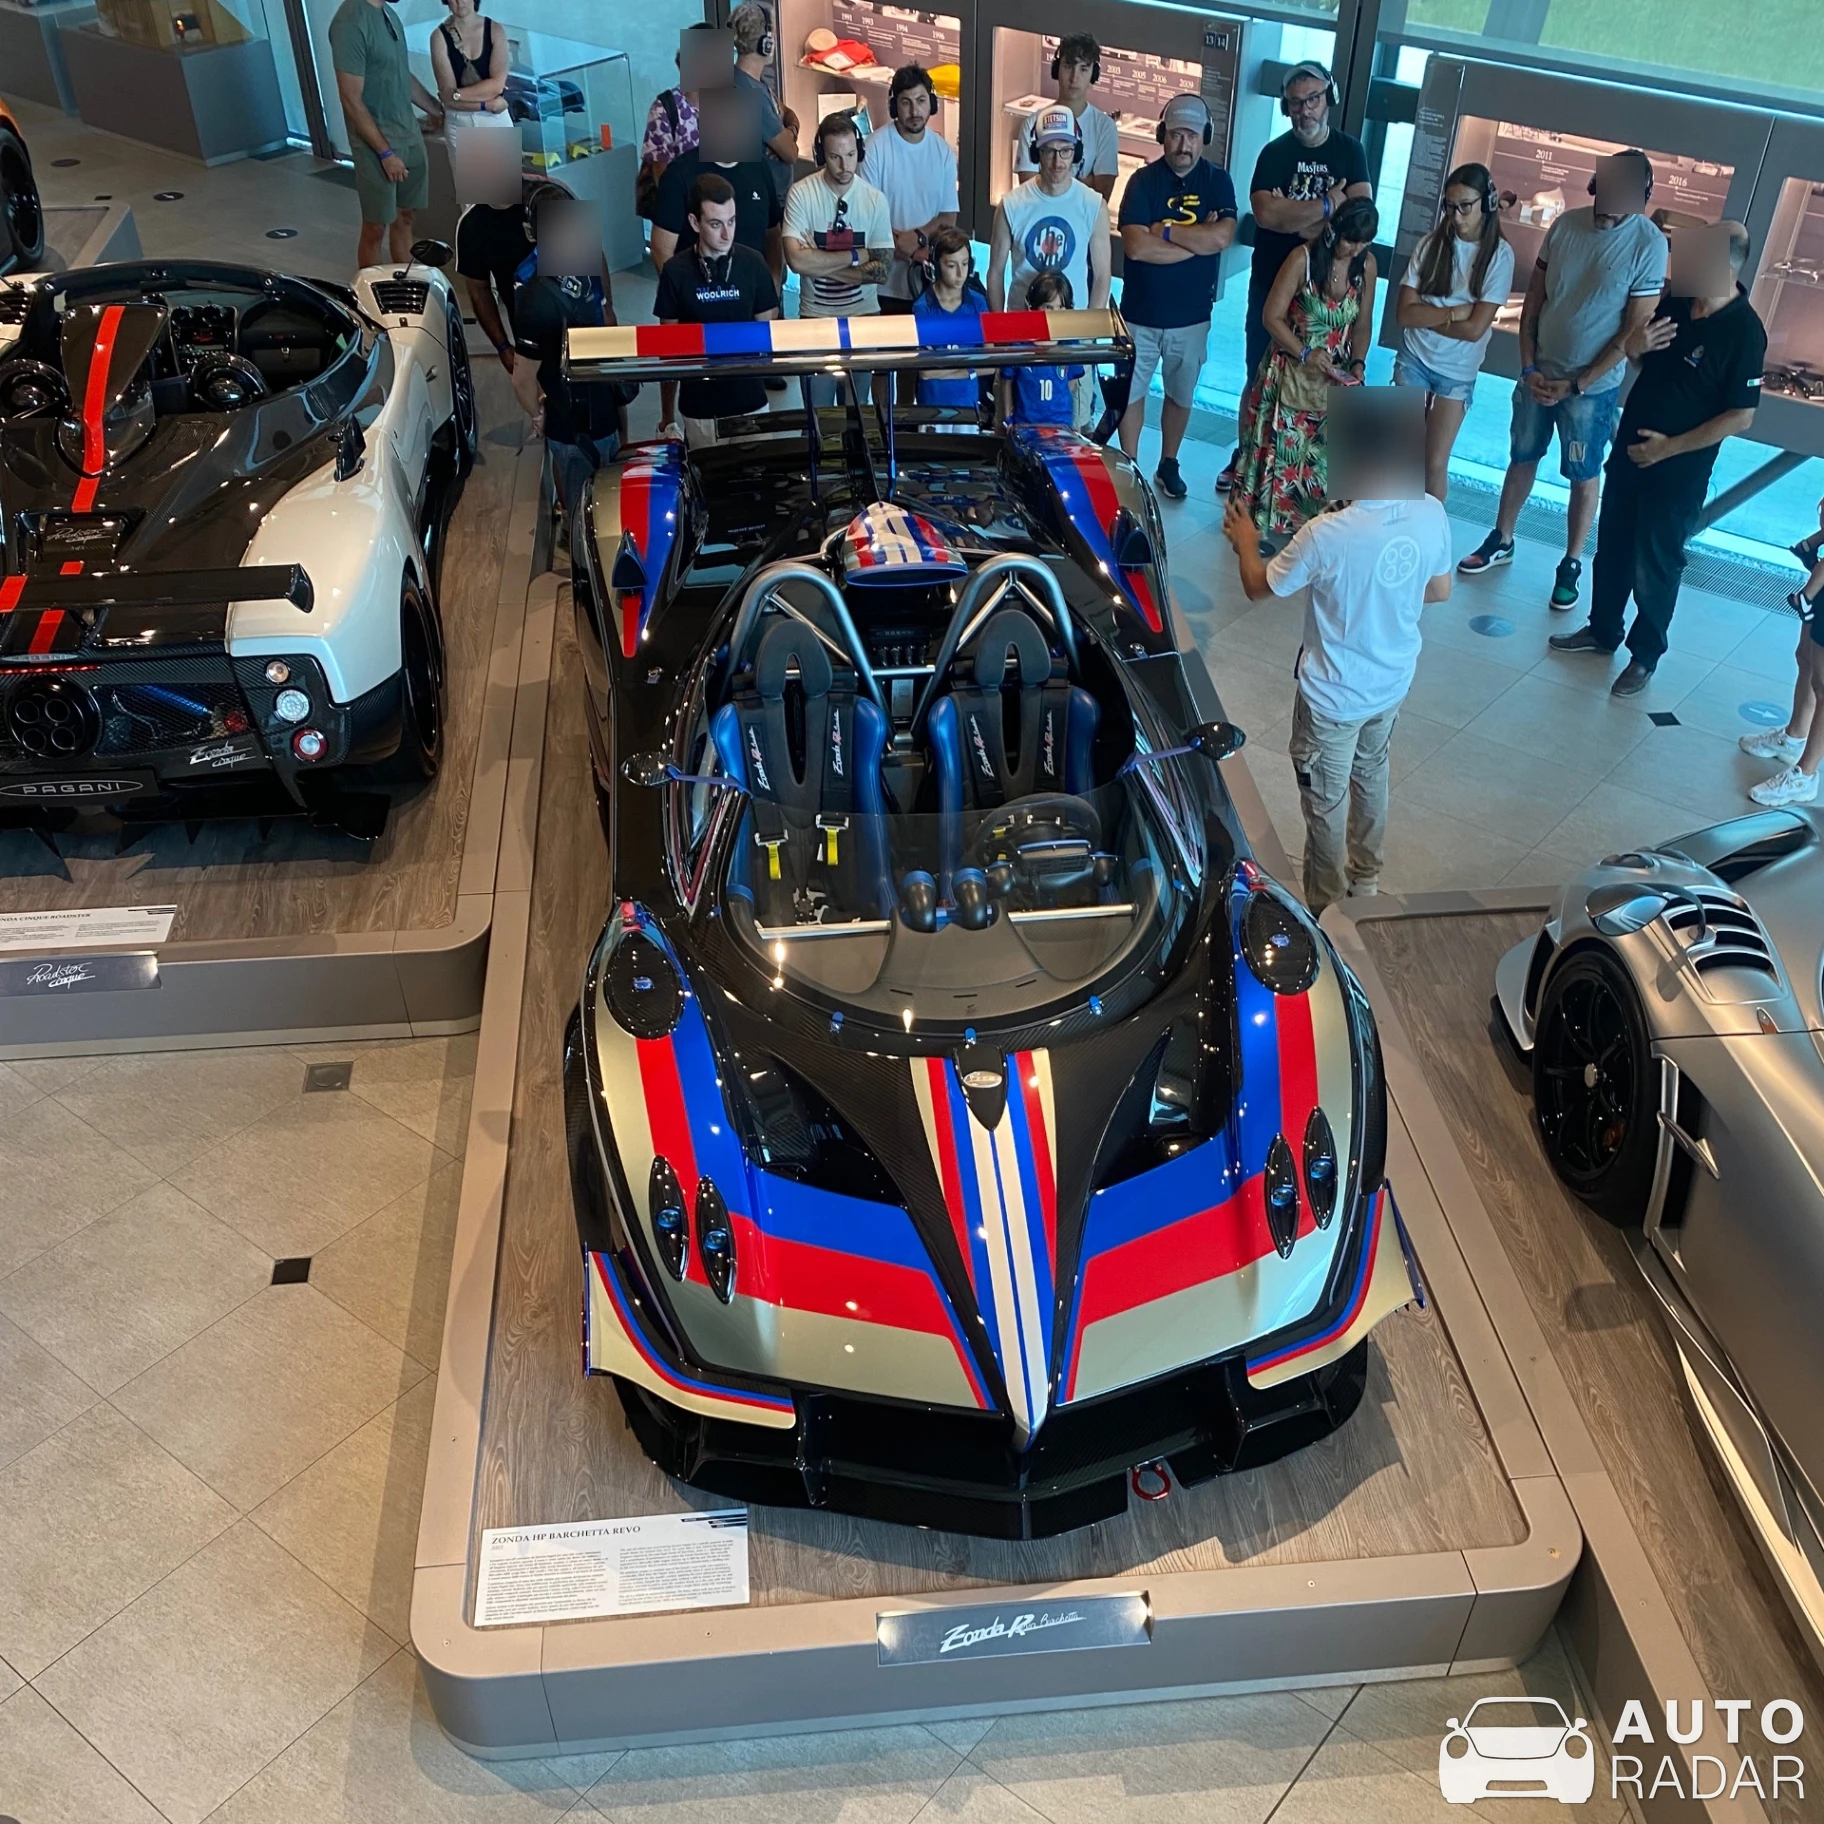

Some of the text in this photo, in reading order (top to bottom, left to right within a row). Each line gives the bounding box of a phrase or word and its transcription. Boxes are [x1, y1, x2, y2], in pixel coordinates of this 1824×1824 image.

[861, 16, 874, 26] 1993
[895, 23, 909, 33] 1994
[931, 30, 945, 40] 1996
[1205, 34, 1214, 44] 13
[1106, 64, 1121, 75] 2003
[1132, 69, 1147, 80] 2005
[1152, 73, 1167, 84] 2006
[1179, 78, 1194, 89] 2009
[1044, 112, 1067, 124] STETSON
[1535, 149, 1688, 187] 2011 2016
[696, 289, 740, 301] WOOLRICH
[1039, 379, 1053, 401] 10
[23, 782, 121, 795] PAGANI
[491, 1525, 641, 1545] ZONDA HP BARCHETTA REVO
[939, 1616, 1006, 1653] Zonda
